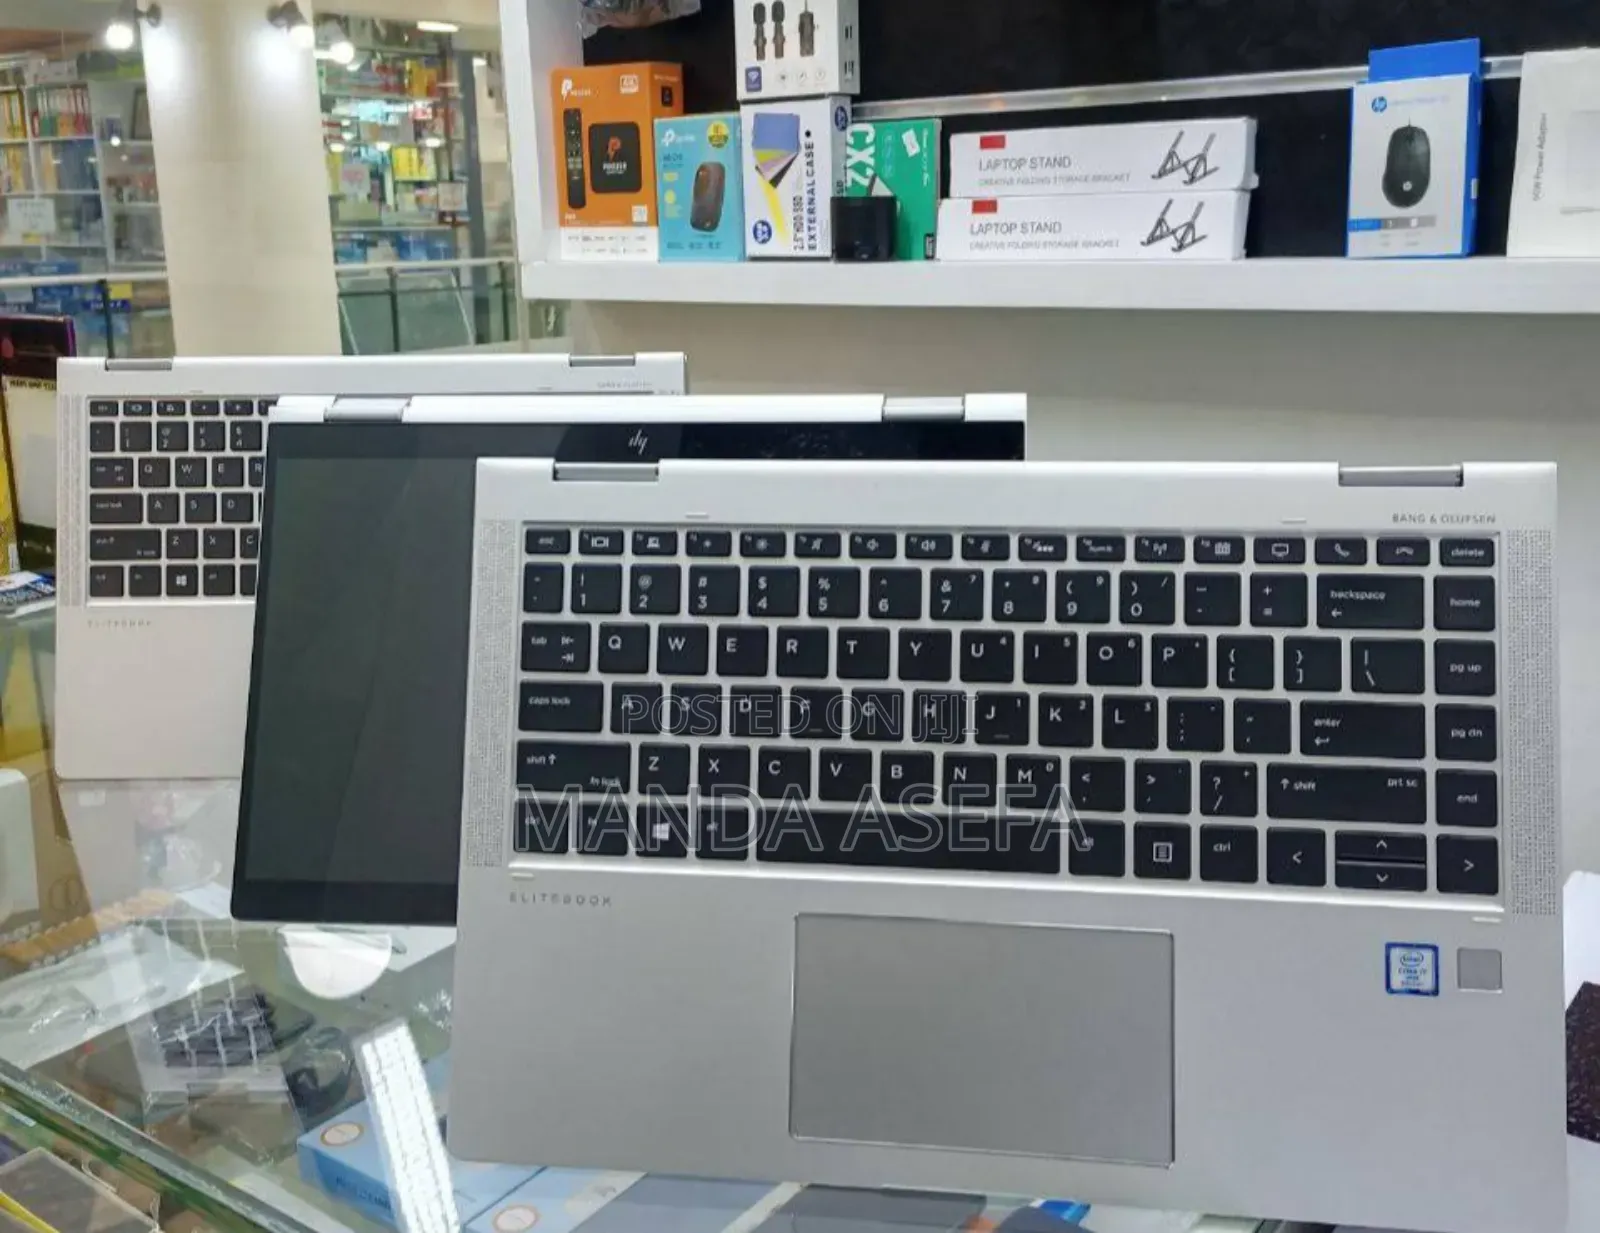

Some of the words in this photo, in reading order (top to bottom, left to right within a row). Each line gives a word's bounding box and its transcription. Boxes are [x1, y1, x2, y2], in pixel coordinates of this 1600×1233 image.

[805, 141, 815, 177] CASE
[847, 123, 876, 188] CX2
[978, 157, 1027, 172] LAPTOP
[1029, 156, 1072, 169] STAND
[979, 176, 1014, 186] CREATIVE
[1017, 176, 1050, 185] FOLDING
[1053, 174, 1089, 184] STORAGE
[1091, 172, 1131, 183] BRACKET
[805, 180, 817, 250] EXTERNAL
[969, 222, 1017, 236] LAPTOP
[1019, 221, 1062, 235] STAND
[969, 240, 1006, 250] CREATIVE
[1081, 238, 1120, 249] BRACKET
[144, 464, 153, 474] Q
[181, 464, 192, 473] W
[217, 464, 225, 473] E
[255, 464, 262, 472] R
[154, 501, 162, 510] A
[190, 500, 197, 510] S
[227, 500, 234, 509] D
[1392, 513, 1426, 524] BANG
[1429, 514, 1437, 523] &
[172, 536, 179, 545] Z
[209, 535, 216, 545] X
[246, 535, 254, 544] C
[1451, 548, 1484, 557] delete
[639, 576, 651, 588] @
[698, 577, 707, 587] #
[759, 577, 767, 589] $
[818, 578, 830, 590] %
[941, 580, 951, 592] &
[1097, 576, 1104, 585] 9
[1067, 581, 1072, 594] (
[1132, 582, 1137, 595] )
[1264, 587, 1271, 595] +
[581, 594, 585, 606] 1
[1330, 590, 1385, 600] backspace
[639, 595, 647, 608] 2
[699, 596, 707, 609] 3
[758, 597, 767, 609] 4
[819, 597, 827, 611] 5
[879, 599, 888, 612] 6
[942, 600, 950, 612] 7
[1004, 601, 1013, 614] 8
[1450, 598, 1480, 607] home
[1067, 602, 1077, 615] 9
[1131, 603, 1142, 616] 0
[531, 636, 547, 645] tab
[608, 635, 621, 649] Q
[668, 638, 685, 650] W
[727, 638, 736, 652] E
[787, 639, 797, 653] R
[1000, 637, 1006, 645] 4
[1064, 638, 1070, 647] 5
[1128, 639, 1135, 648] 6
[847, 641, 857, 653] T
[911, 642, 921, 655] Y
[971, 644, 983, 657] U
[1099, 646, 1113, 660] O
[1164, 647, 1175, 660] P
[1230, 649, 1234, 662] {
[1297, 650, 1302, 664] }
[1229, 667, 1234, 682] [
[1450, 664, 1464, 673] pg
[1467, 664, 1482, 673] up
[1297, 669, 1302, 683] ]
[1366, 671, 1374, 686] \
[551, 696, 570, 706] lock
[621, 696, 634, 710] A
[681, 698, 691, 711] S
[739, 698, 751, 712] D
[1080, 700, 1086, 710] 2
[800, 700, 811, 715] F
[862, 702, 875, 716] G
[924, 704, 936, 718] H
[986, 706, 995, 719] J
[1050, 708, 1061, 721] K
[1115, 709, 1124, 723] L
[1314, 718, 1341, 727] enter
[1451, 728, 1466, 738] pg
[1468, 728, 1483, 737] dn
[526, 754, 546, 765] shift
[649, 756, 659, 771] Z
[709, 759, 719, 772] X
[769, 760, 780, 775] C
[830, 763, 842, 776] V
[892, 765, 902, 778] B
[954, 767, 966, 780] N
[1017, 768, 1033, 783] M
[1148, 775, 1155, 784] >
[602, 778, 621, 787] lock
[1213, 777, 1220, 789] ?
[1293, 781, 1316, 791] shift
[1387, 778, 1403, 788] prt
[1406, 779, 1418, 787] sc
[1214, 796, 1222, 810] /
[1456, 793, 1478, 803] end
[1213, 842, 1231, 852] ctrl
